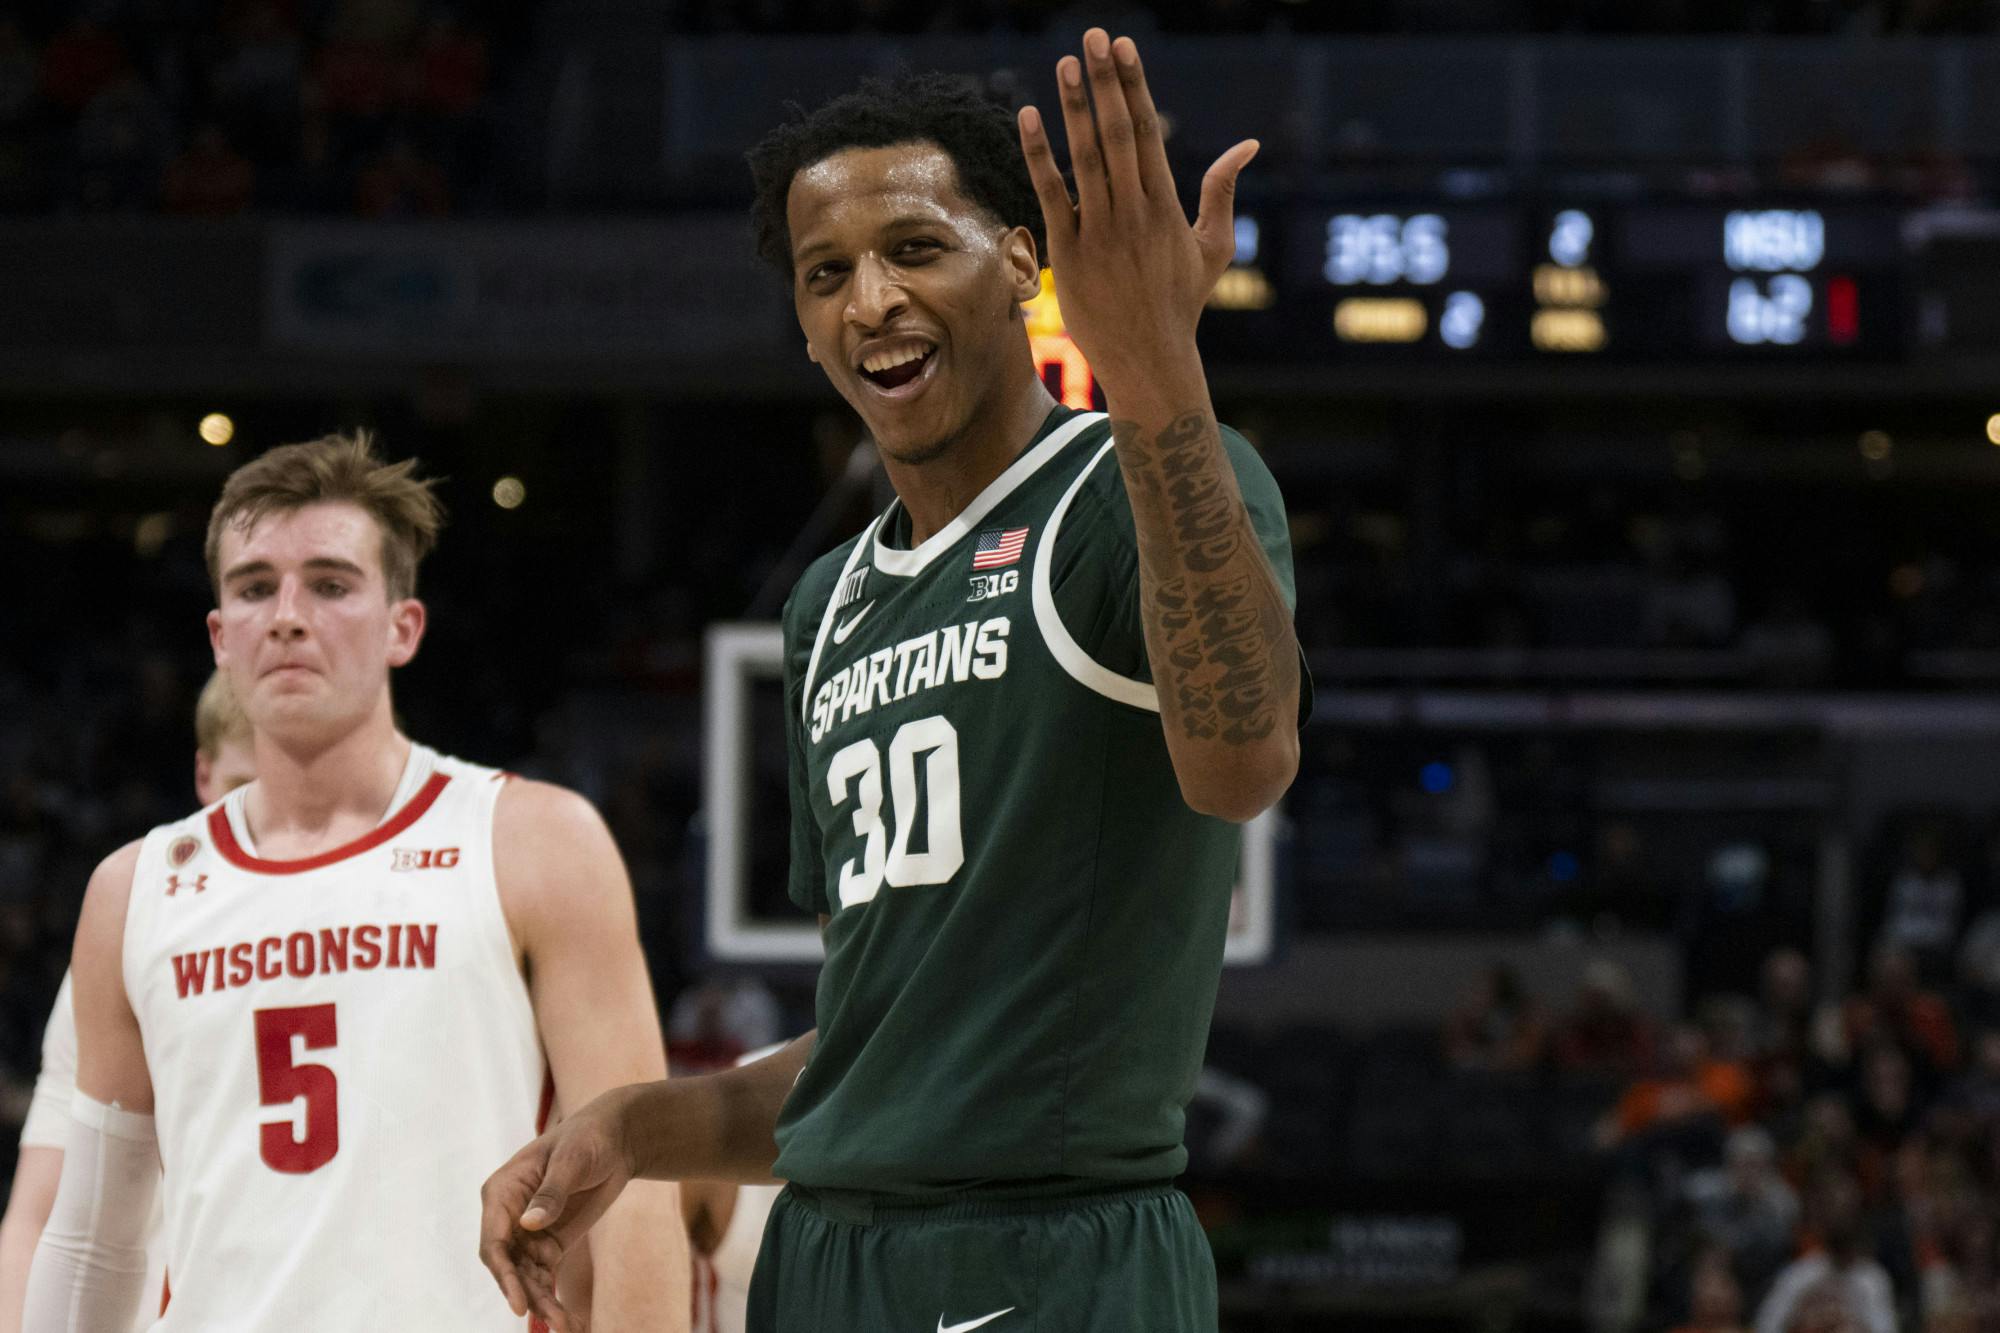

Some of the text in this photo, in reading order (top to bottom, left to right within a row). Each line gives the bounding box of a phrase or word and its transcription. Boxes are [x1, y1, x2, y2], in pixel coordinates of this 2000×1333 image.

[1155, 407, 1277, 745] GRAND RAPIDS
[811, 616, 1011, 744] SPARTANS
[826, 714, 964, 910] 30
[171, 923, 438, 999] WISCONSIN
[254, 1003, 339, 1175] 5
